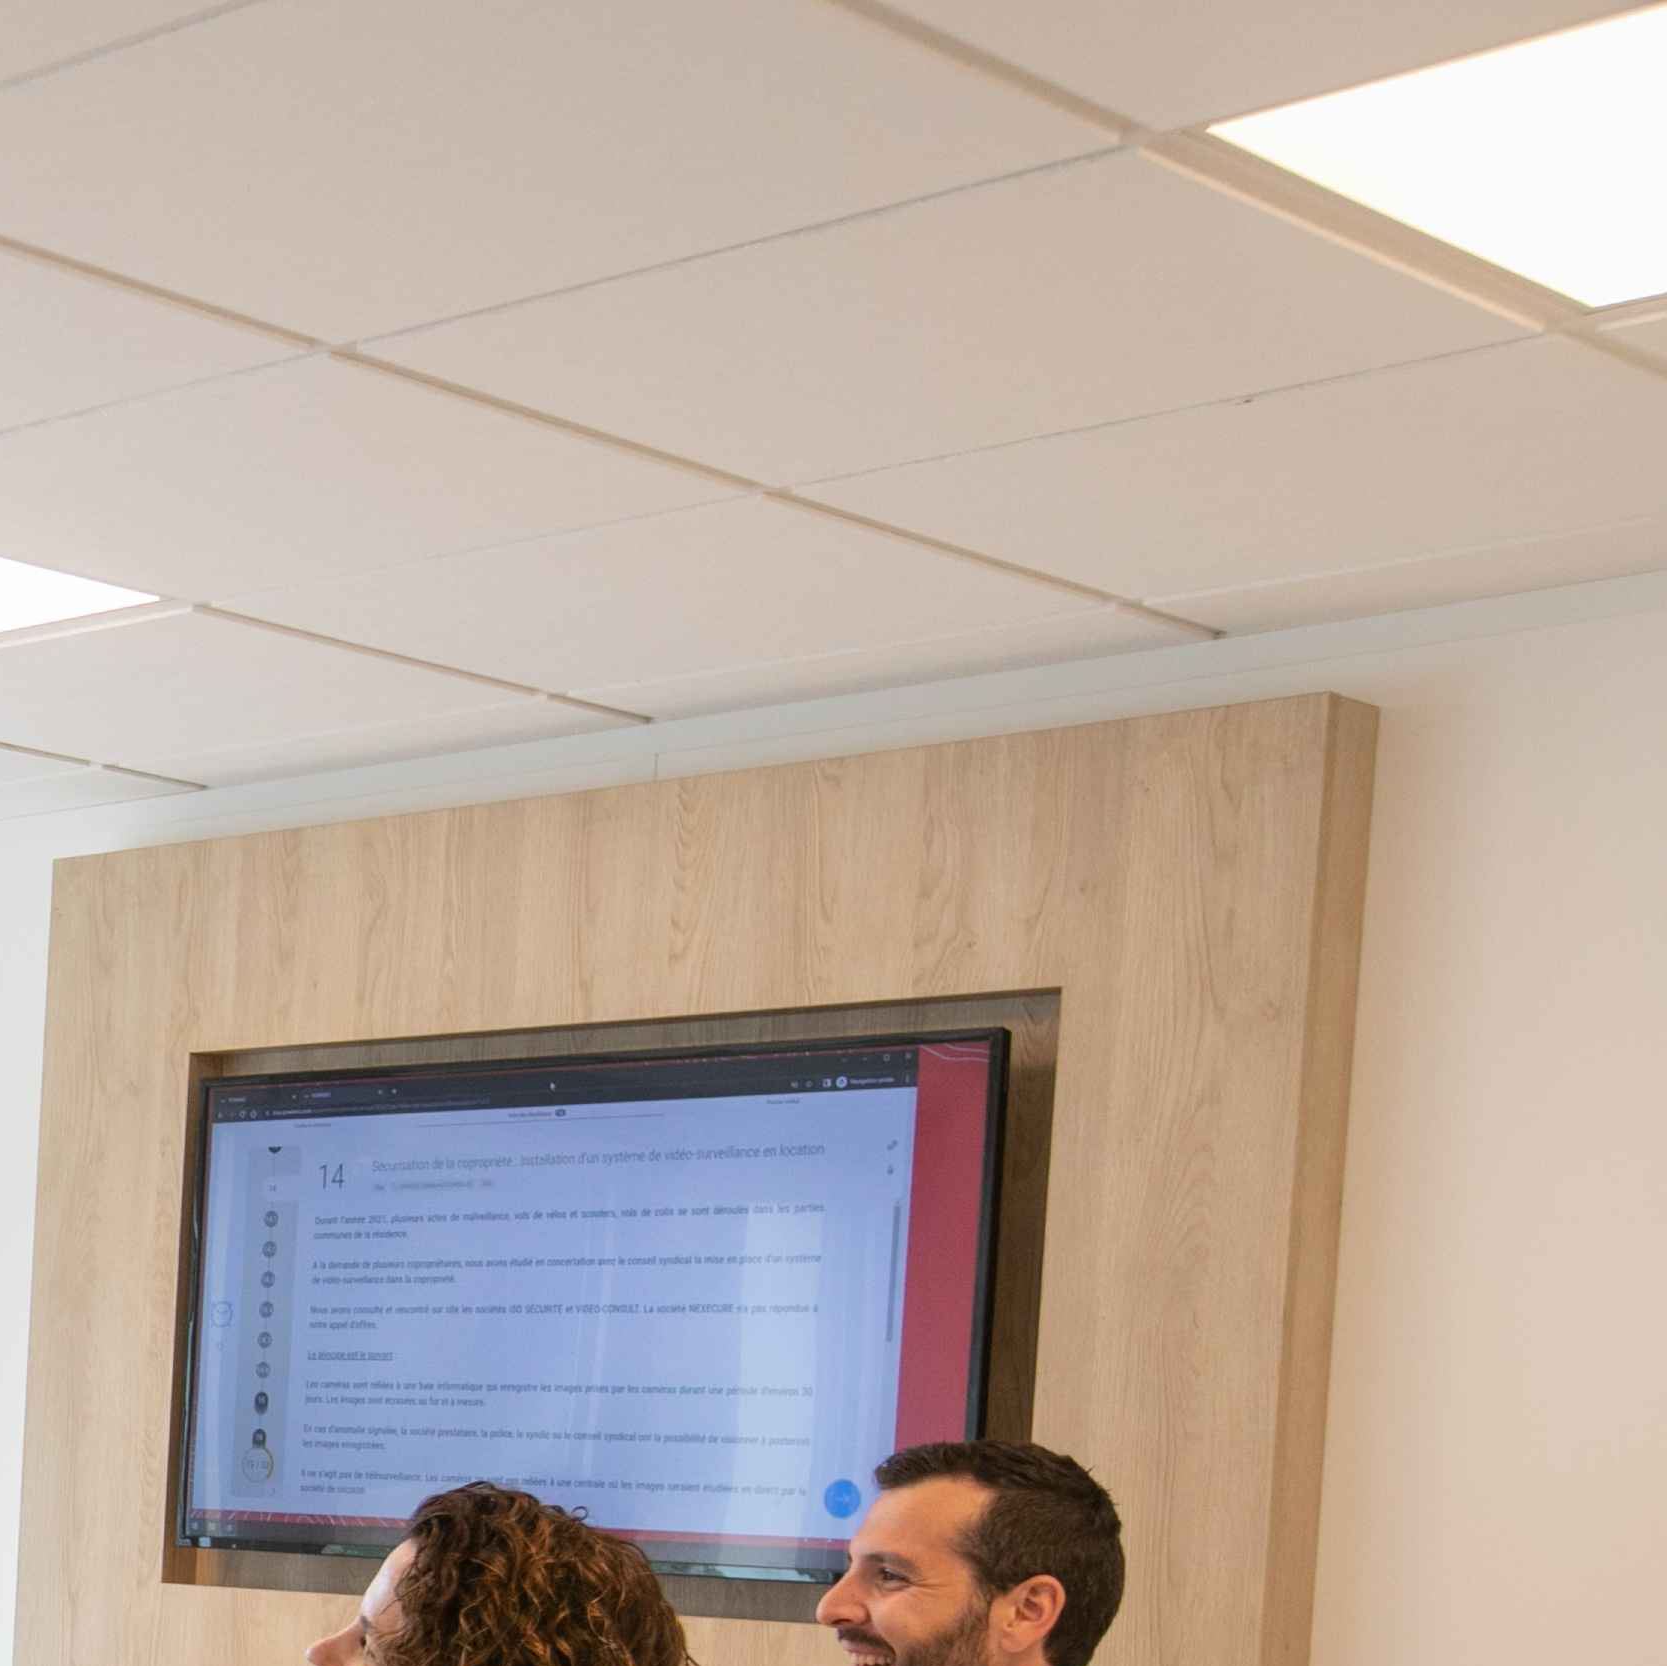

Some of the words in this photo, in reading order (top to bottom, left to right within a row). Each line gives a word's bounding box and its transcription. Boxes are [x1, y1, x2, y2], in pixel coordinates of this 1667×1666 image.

[431, 1158, 445, 1170] de
[446, 1157, 456, 1169] la
[520, 1153, 576, 1166] Installation
[577, 1152, 600, 1164] d'un
[648, 1149, 662, 1161] de
[763, 1148, 777, 1157] en
[779, 1143, 826, 1156] location
[319, 1163, 345, 1190] 14
